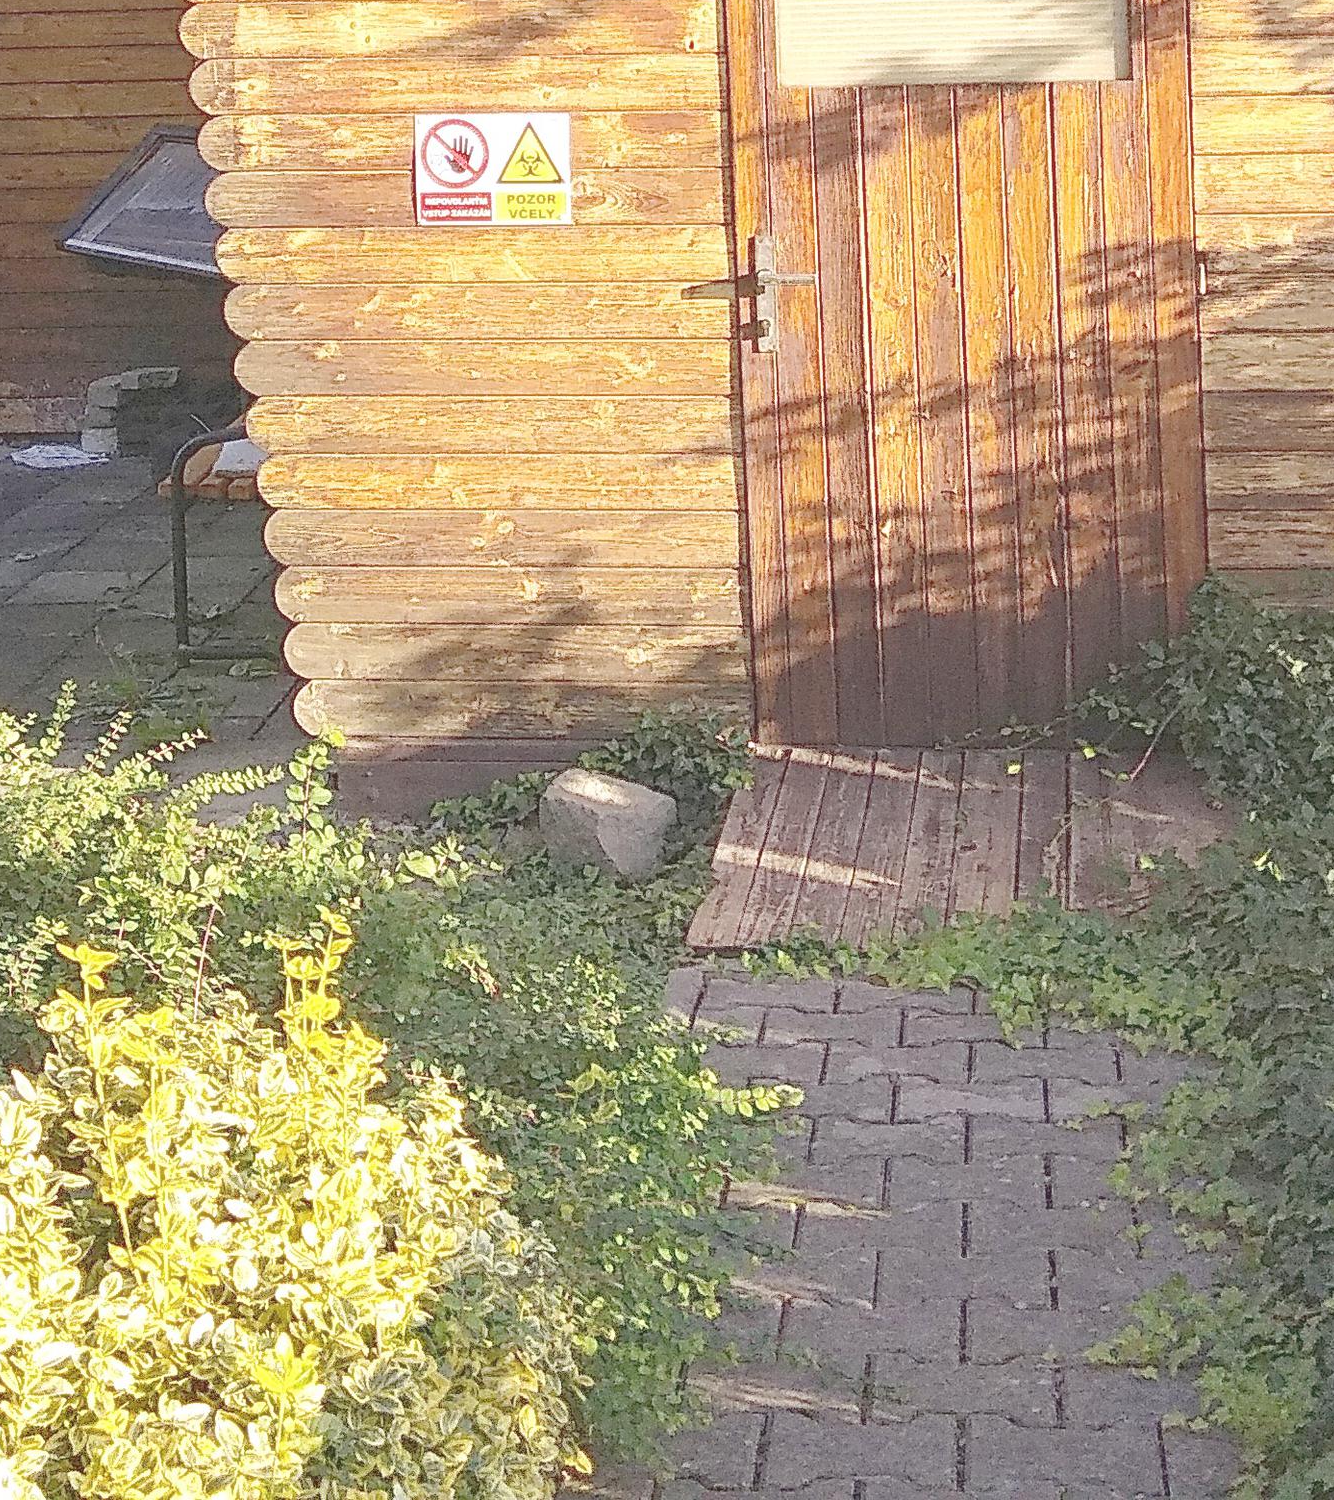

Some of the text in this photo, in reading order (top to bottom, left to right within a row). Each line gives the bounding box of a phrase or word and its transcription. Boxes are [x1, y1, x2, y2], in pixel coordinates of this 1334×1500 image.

[506, 194, 556, 205] POZOR
[422, 207, 450, 218] VSTUP
[509, 207, 555, 220] VČELY
